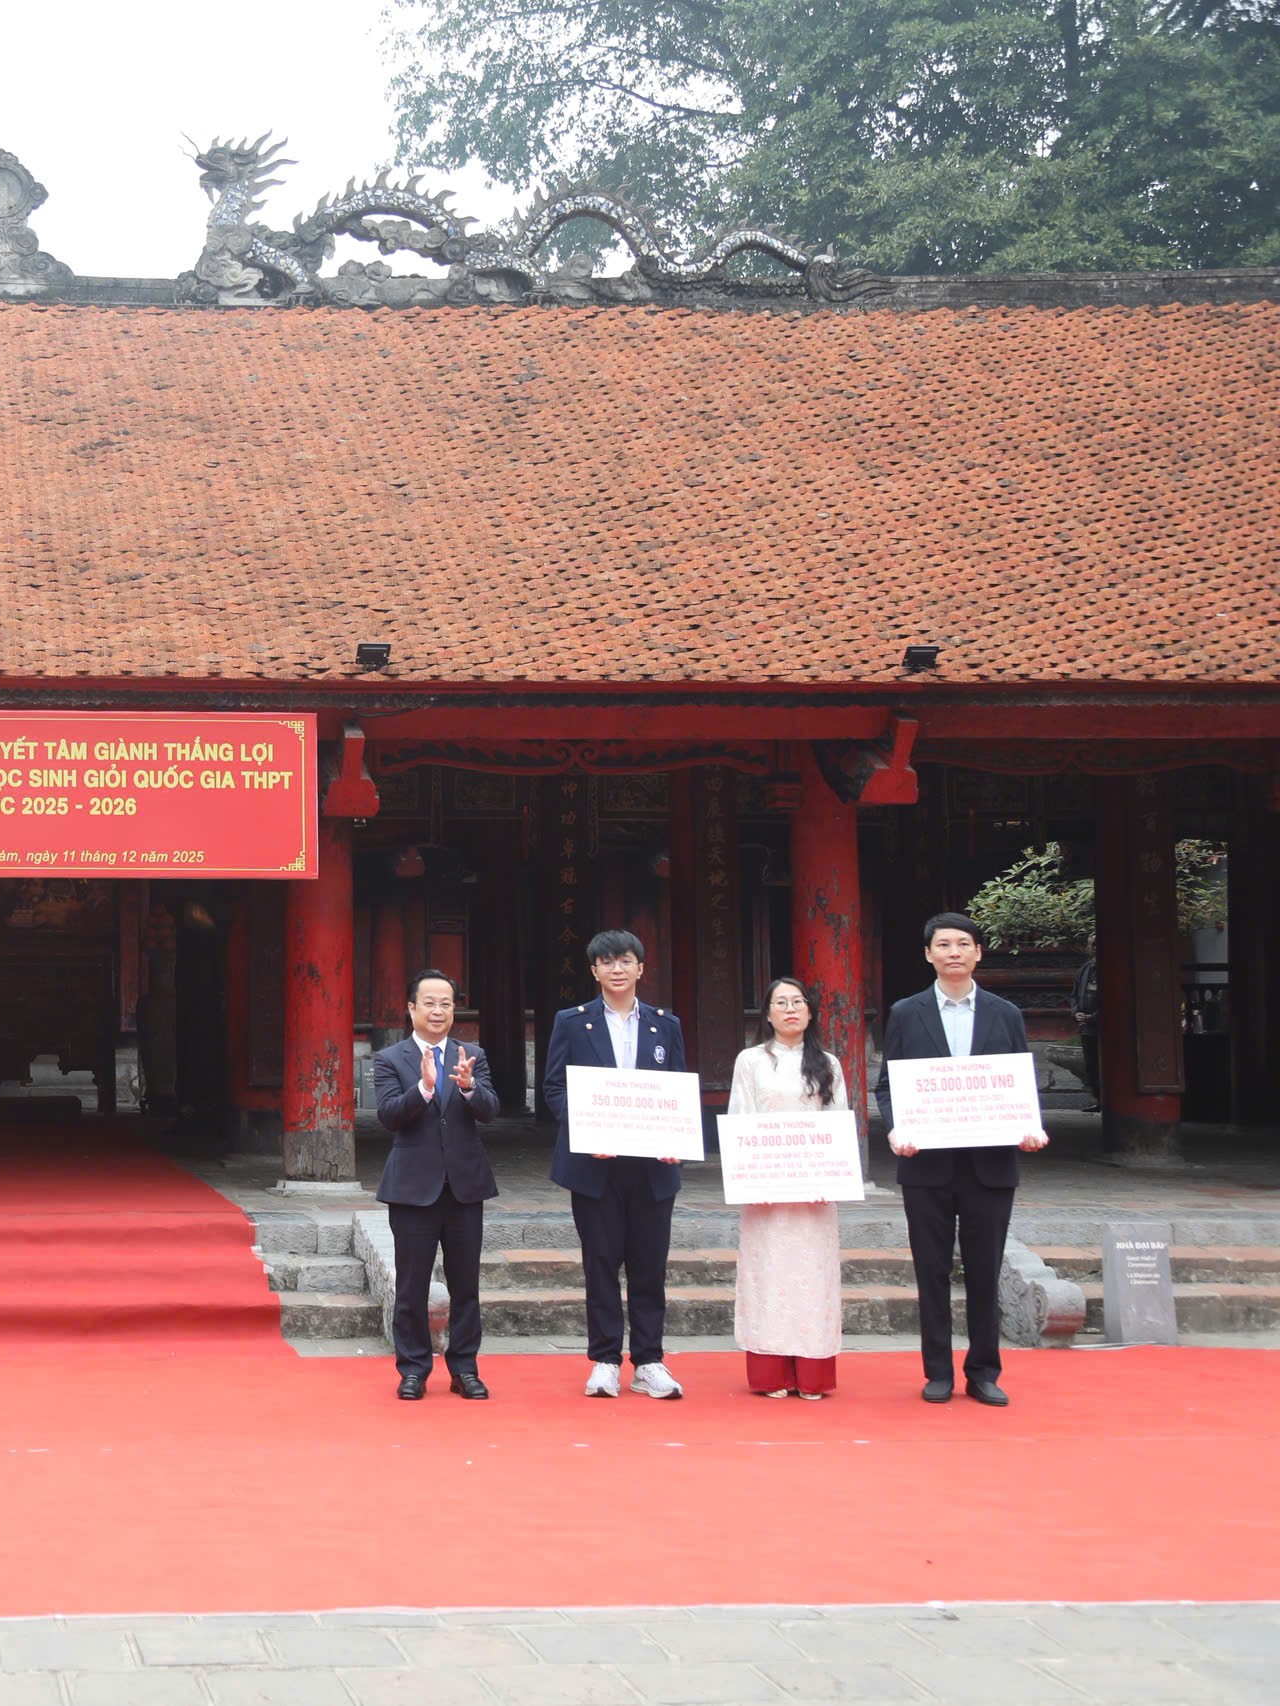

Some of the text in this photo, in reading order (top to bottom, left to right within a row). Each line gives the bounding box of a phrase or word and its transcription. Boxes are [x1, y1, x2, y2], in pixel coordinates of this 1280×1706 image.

[43, 738, 91, 761] TÂM
[93, 736, 159, 762] GIÀNH
[162, 736, 235, 763] THẮNG
[239, 743, 275, 765] LỢI
[27, 768, 78, 788] SINH
[83, 764, 128, 789] GIỎI
[132, 764, 196, 790] QUỐC
[199, 768, 236, 790] GIA
[240, 768, 295, 790] THPT
[21, 795, 70, 816] 2025
[88, 795, 139, 816] 2026
[26, 848, 57, 865] ngày
[62, 849, 76, 863] 11
[78, 849, 116, 866] tháng
[122, 850, 137, 863] 12
[140, 850, 170, 864] năm
[172, 850, 205, 864] 2025
[915, 1074, 1015, 1092] 525.000.000 VNĐ
[592, 1094, 679, 1110] 350.000.000 VNĐ
[737, 1133, 832, 1147] 749.000.000 VNĐ
